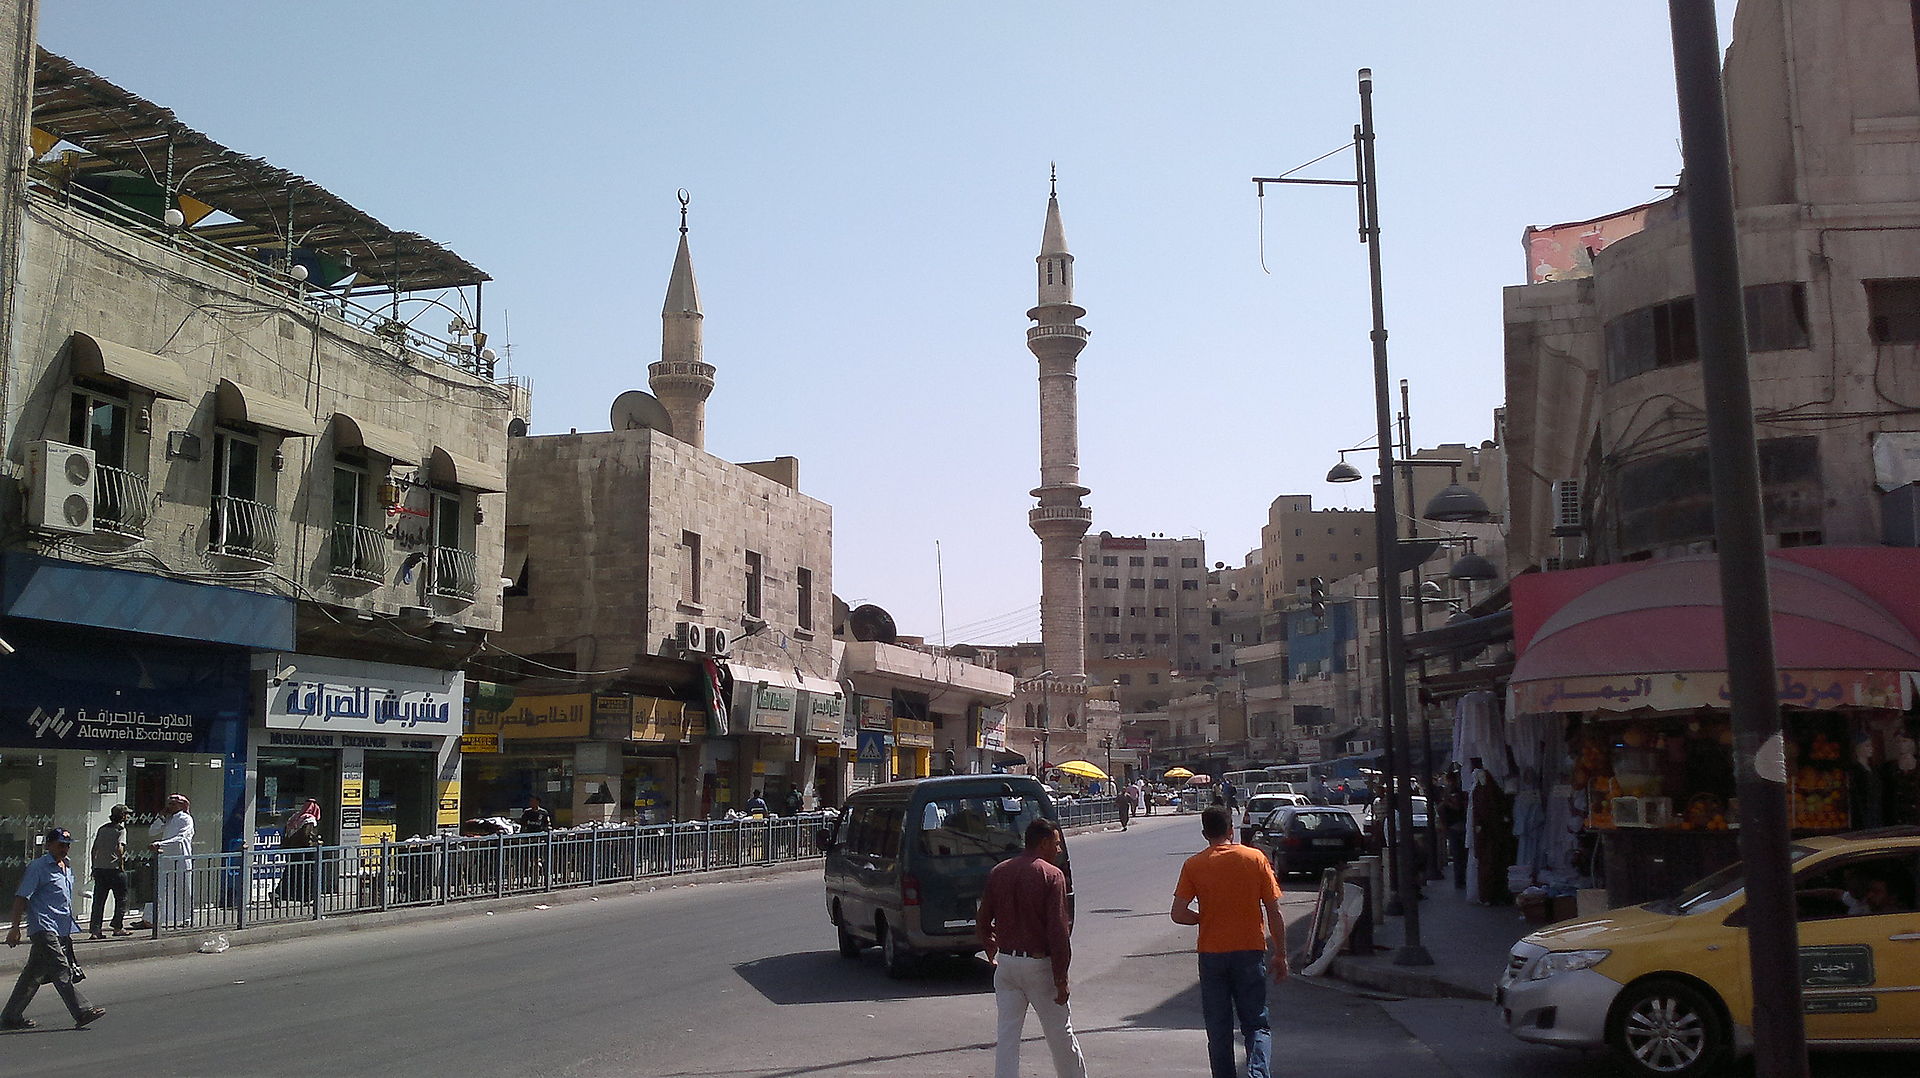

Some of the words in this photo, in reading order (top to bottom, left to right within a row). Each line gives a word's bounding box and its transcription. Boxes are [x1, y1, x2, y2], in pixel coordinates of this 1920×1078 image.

[286, 682, 370, 722] للصرافة
[77, 708, 137, 726] للصرافة
[77, 725, 134, 740] Alawneh
[135, 727, 193, 744] Exchange
[270, 731, 334, 747] MUSHARBASH
[341, 735, 387, 748] EXCHANGE
